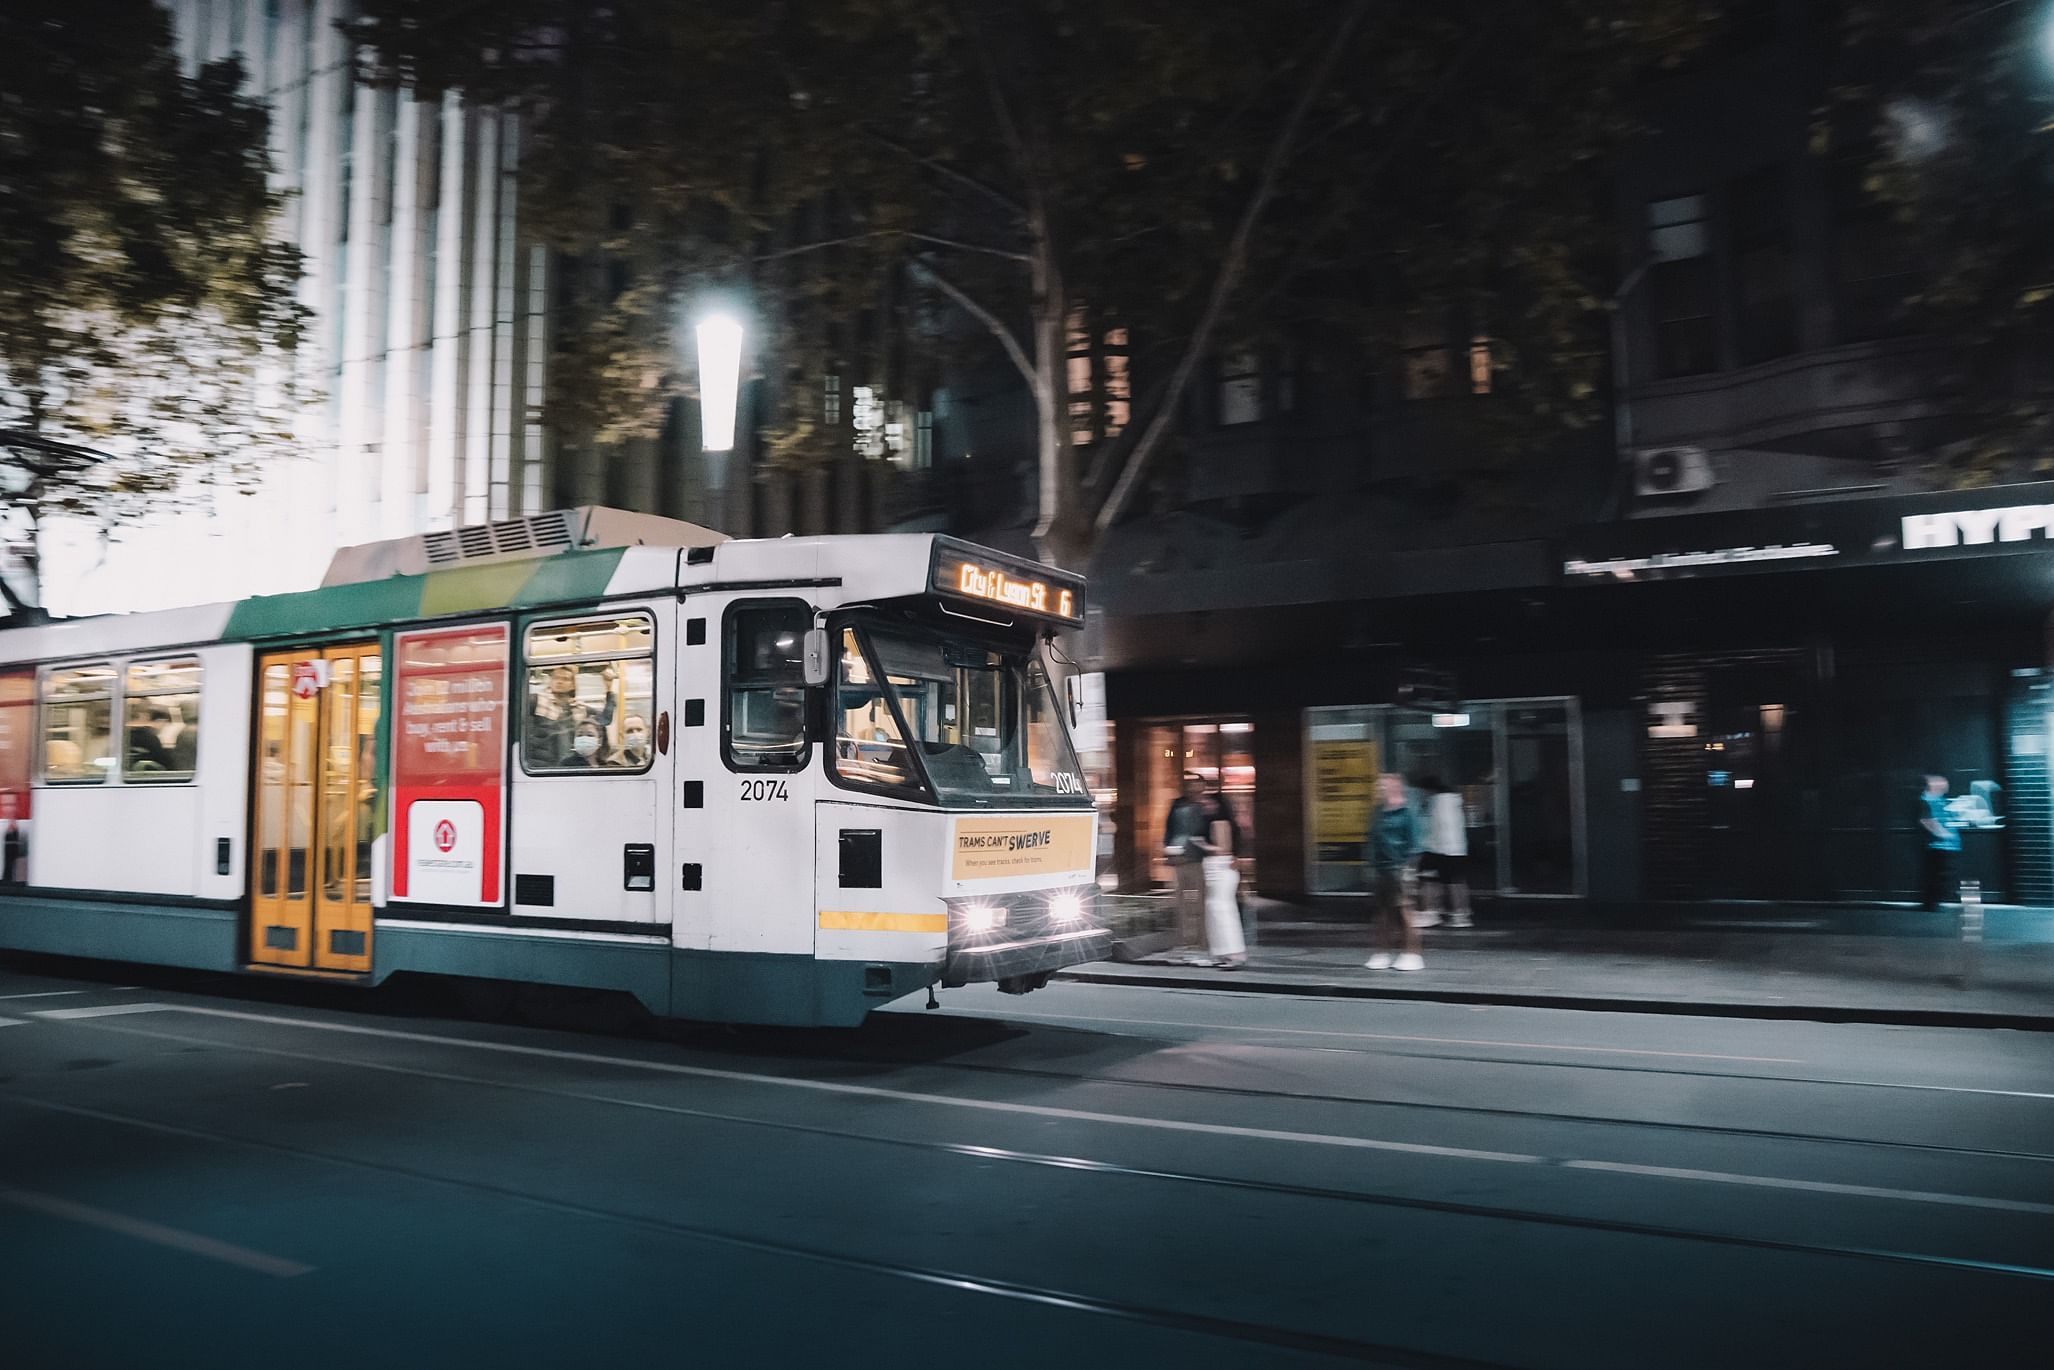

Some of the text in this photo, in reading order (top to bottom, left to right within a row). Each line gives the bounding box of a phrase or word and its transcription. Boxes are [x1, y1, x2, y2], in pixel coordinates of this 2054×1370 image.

[1901, 503, 2054, 550] HYP
[961, 563, 987, 596] City
[1060, 589, 1073, 618] 6
[740, 780, 789, 801] 2074
[1050, 772, 1083, 794] 2074
[959, 830, 1051, 851] TRAMS CAN'T SWERVE
